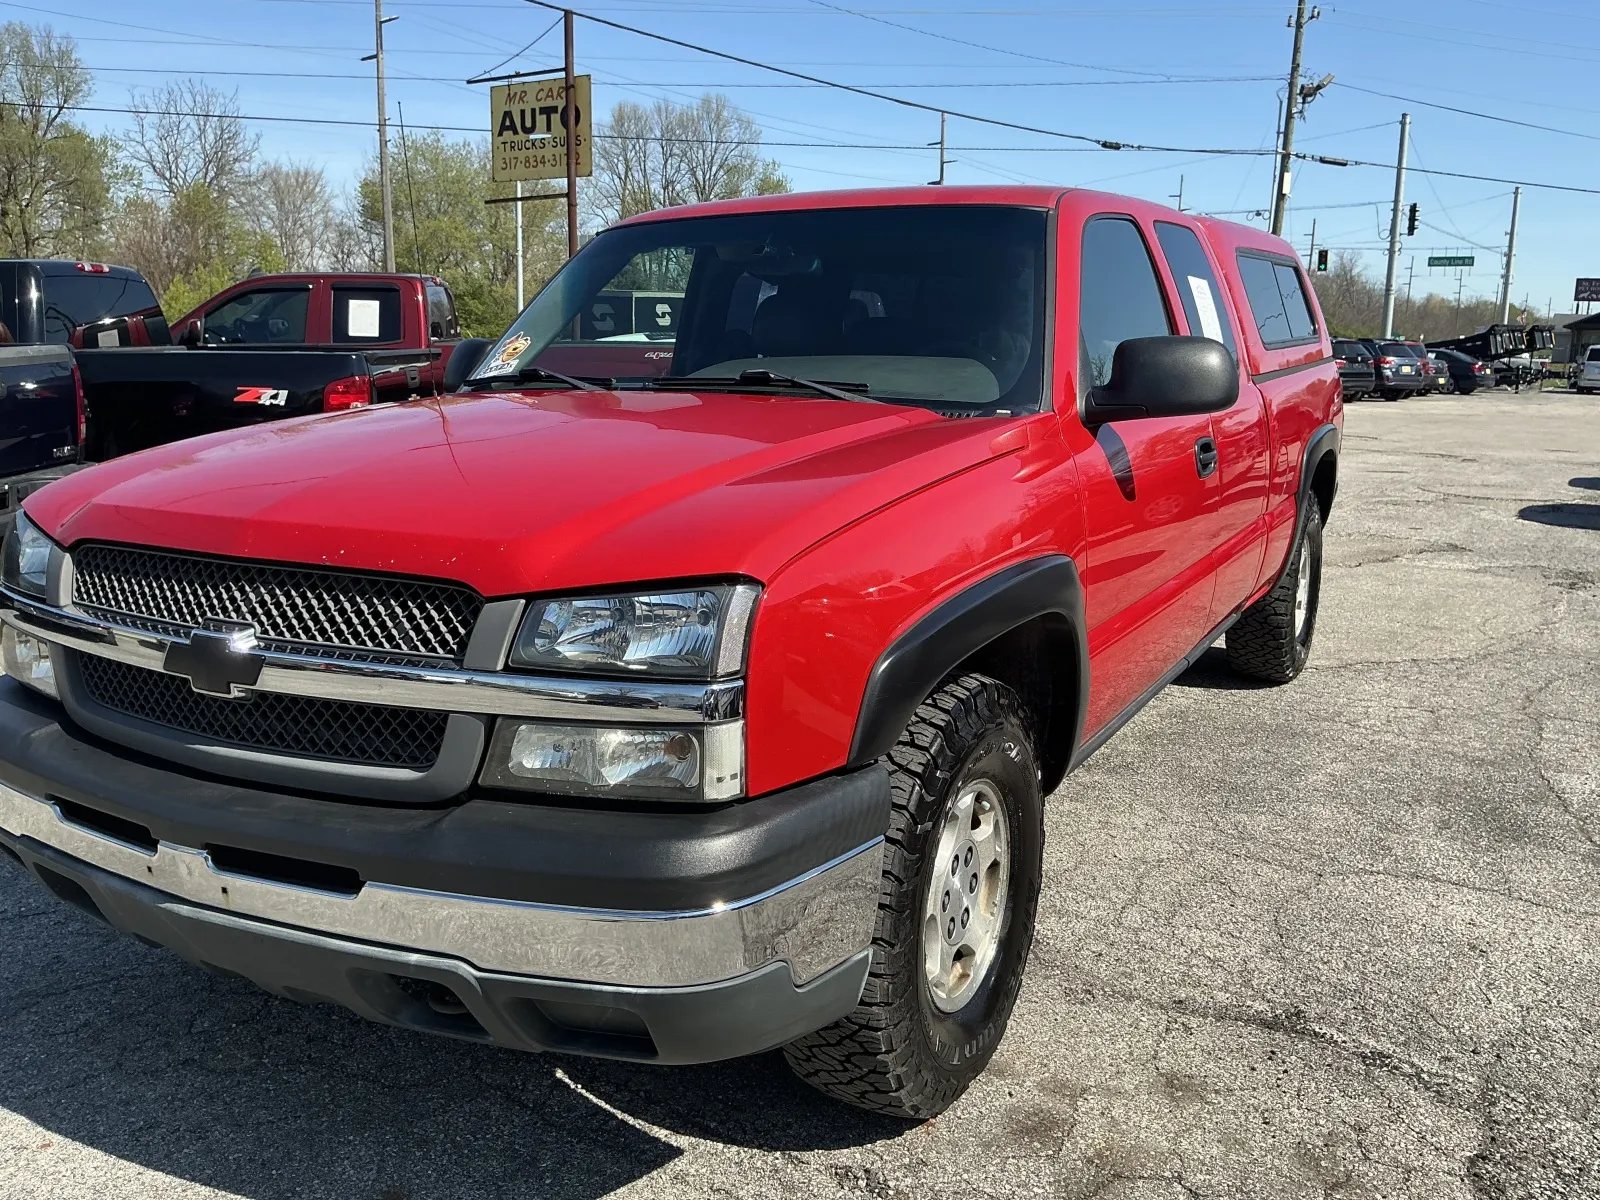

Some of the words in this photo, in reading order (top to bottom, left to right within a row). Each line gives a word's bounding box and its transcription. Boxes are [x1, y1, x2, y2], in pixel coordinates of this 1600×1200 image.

[505, 90, 529, 106] MR.
[497, 105, 581, 137] AUTO
[501, 138, 546, 152] TRUCKS
[551, 134, 582, 148] SUS
[1430, 258, 1449, 266] County
[233, 386, 289, 406] Z71
